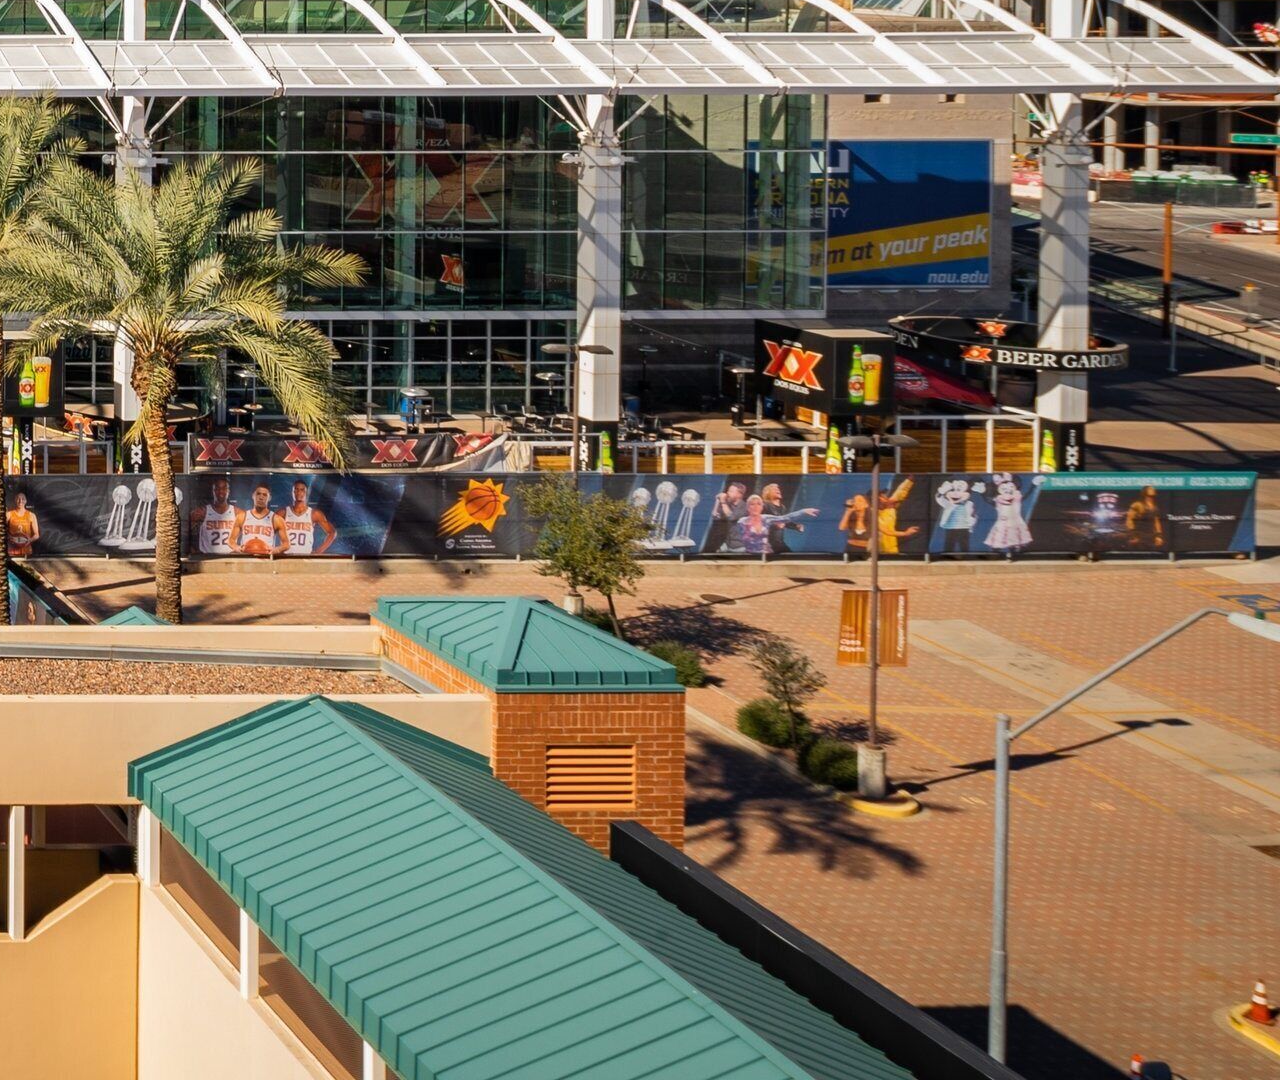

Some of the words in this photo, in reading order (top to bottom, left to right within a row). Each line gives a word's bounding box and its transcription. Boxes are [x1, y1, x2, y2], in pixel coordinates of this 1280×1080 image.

[851, 241, 874, 261] at
[879, 235, 929, 261] your
[933, 224, 988, 253] peak
[928, 271, 989, 284] nau.edu
[762, 339, 825, 392] XX
[997, 349, 1058, 367] BEER
[1061, 354, 1128, 369] GARDEN
[196, 438, 243, 461] XX
[370, 438, 419, 463] XX
[206, 520, 234, 531] SUNS
[244, 524, 272, 538] SUNS
[211, 531, 231, 546] 22
[290, 532, 307, 546] 20
